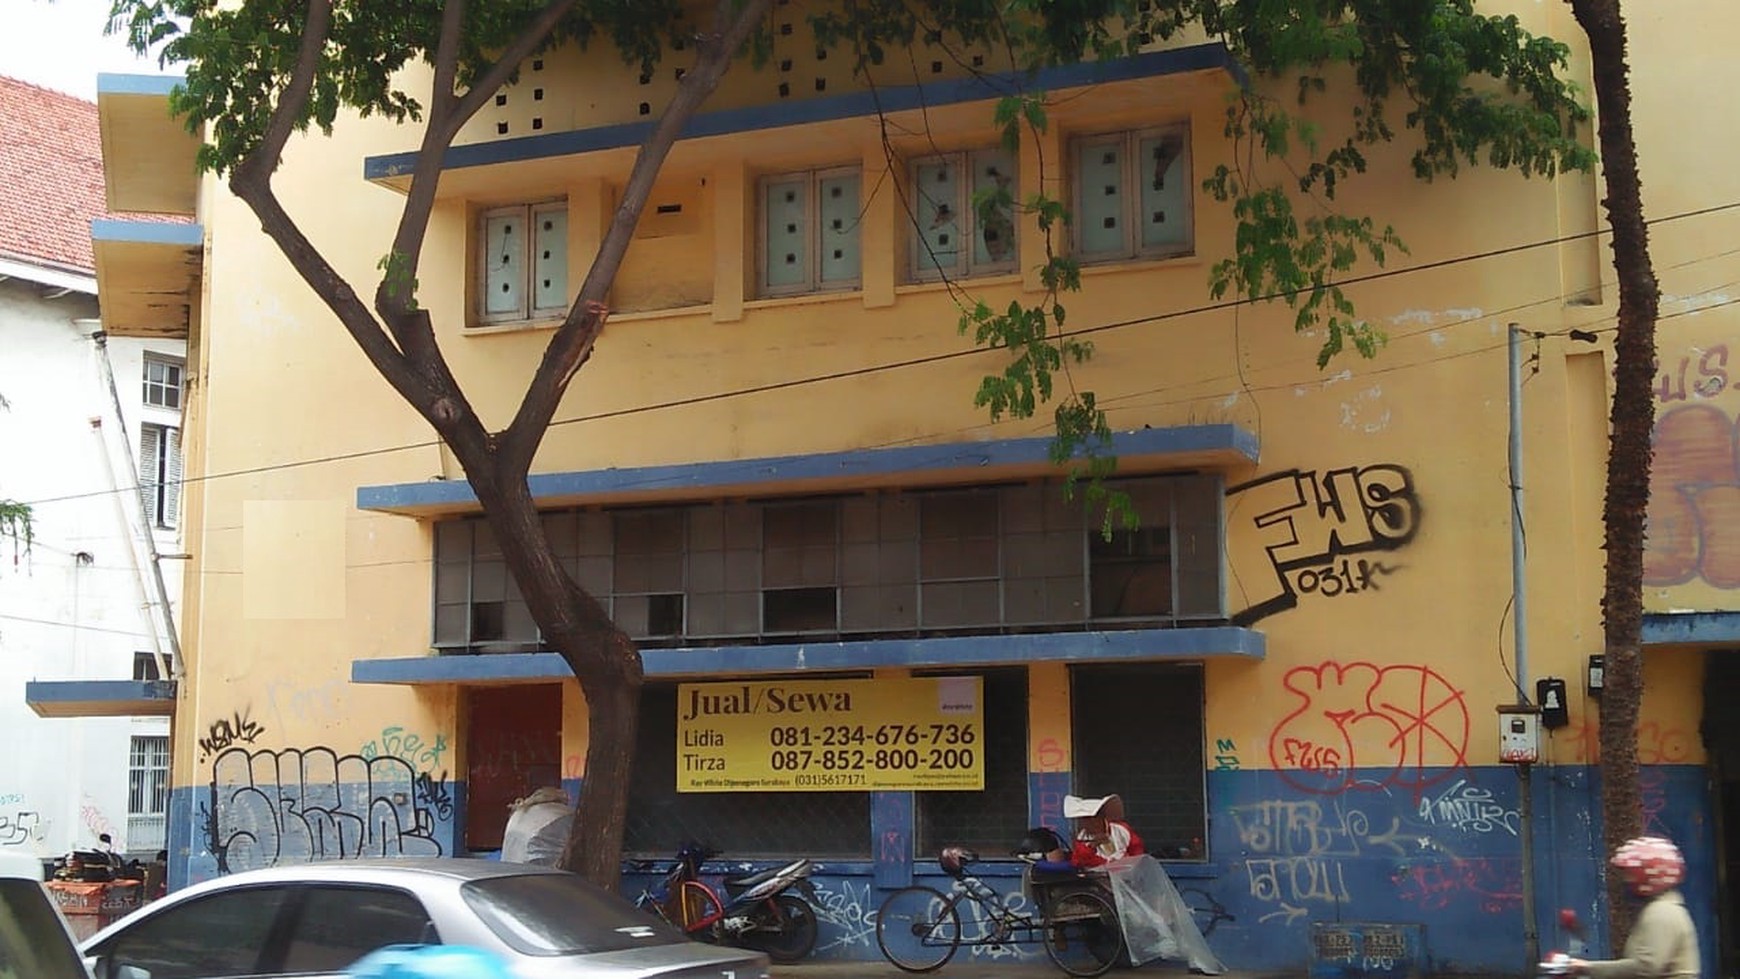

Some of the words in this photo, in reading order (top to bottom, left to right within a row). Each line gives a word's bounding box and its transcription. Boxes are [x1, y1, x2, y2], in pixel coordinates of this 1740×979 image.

[683, 686, 852, 721] Jual/Sewa
[684, 730, 724, 747] Lidia
[770, 724, 976, 747] 081-234-676-736
[683, 754, 726, 771] Tirza
[771, 749, 974, 771] 087-852-800-200
[794, 773, 867, 787] (031)5617171
